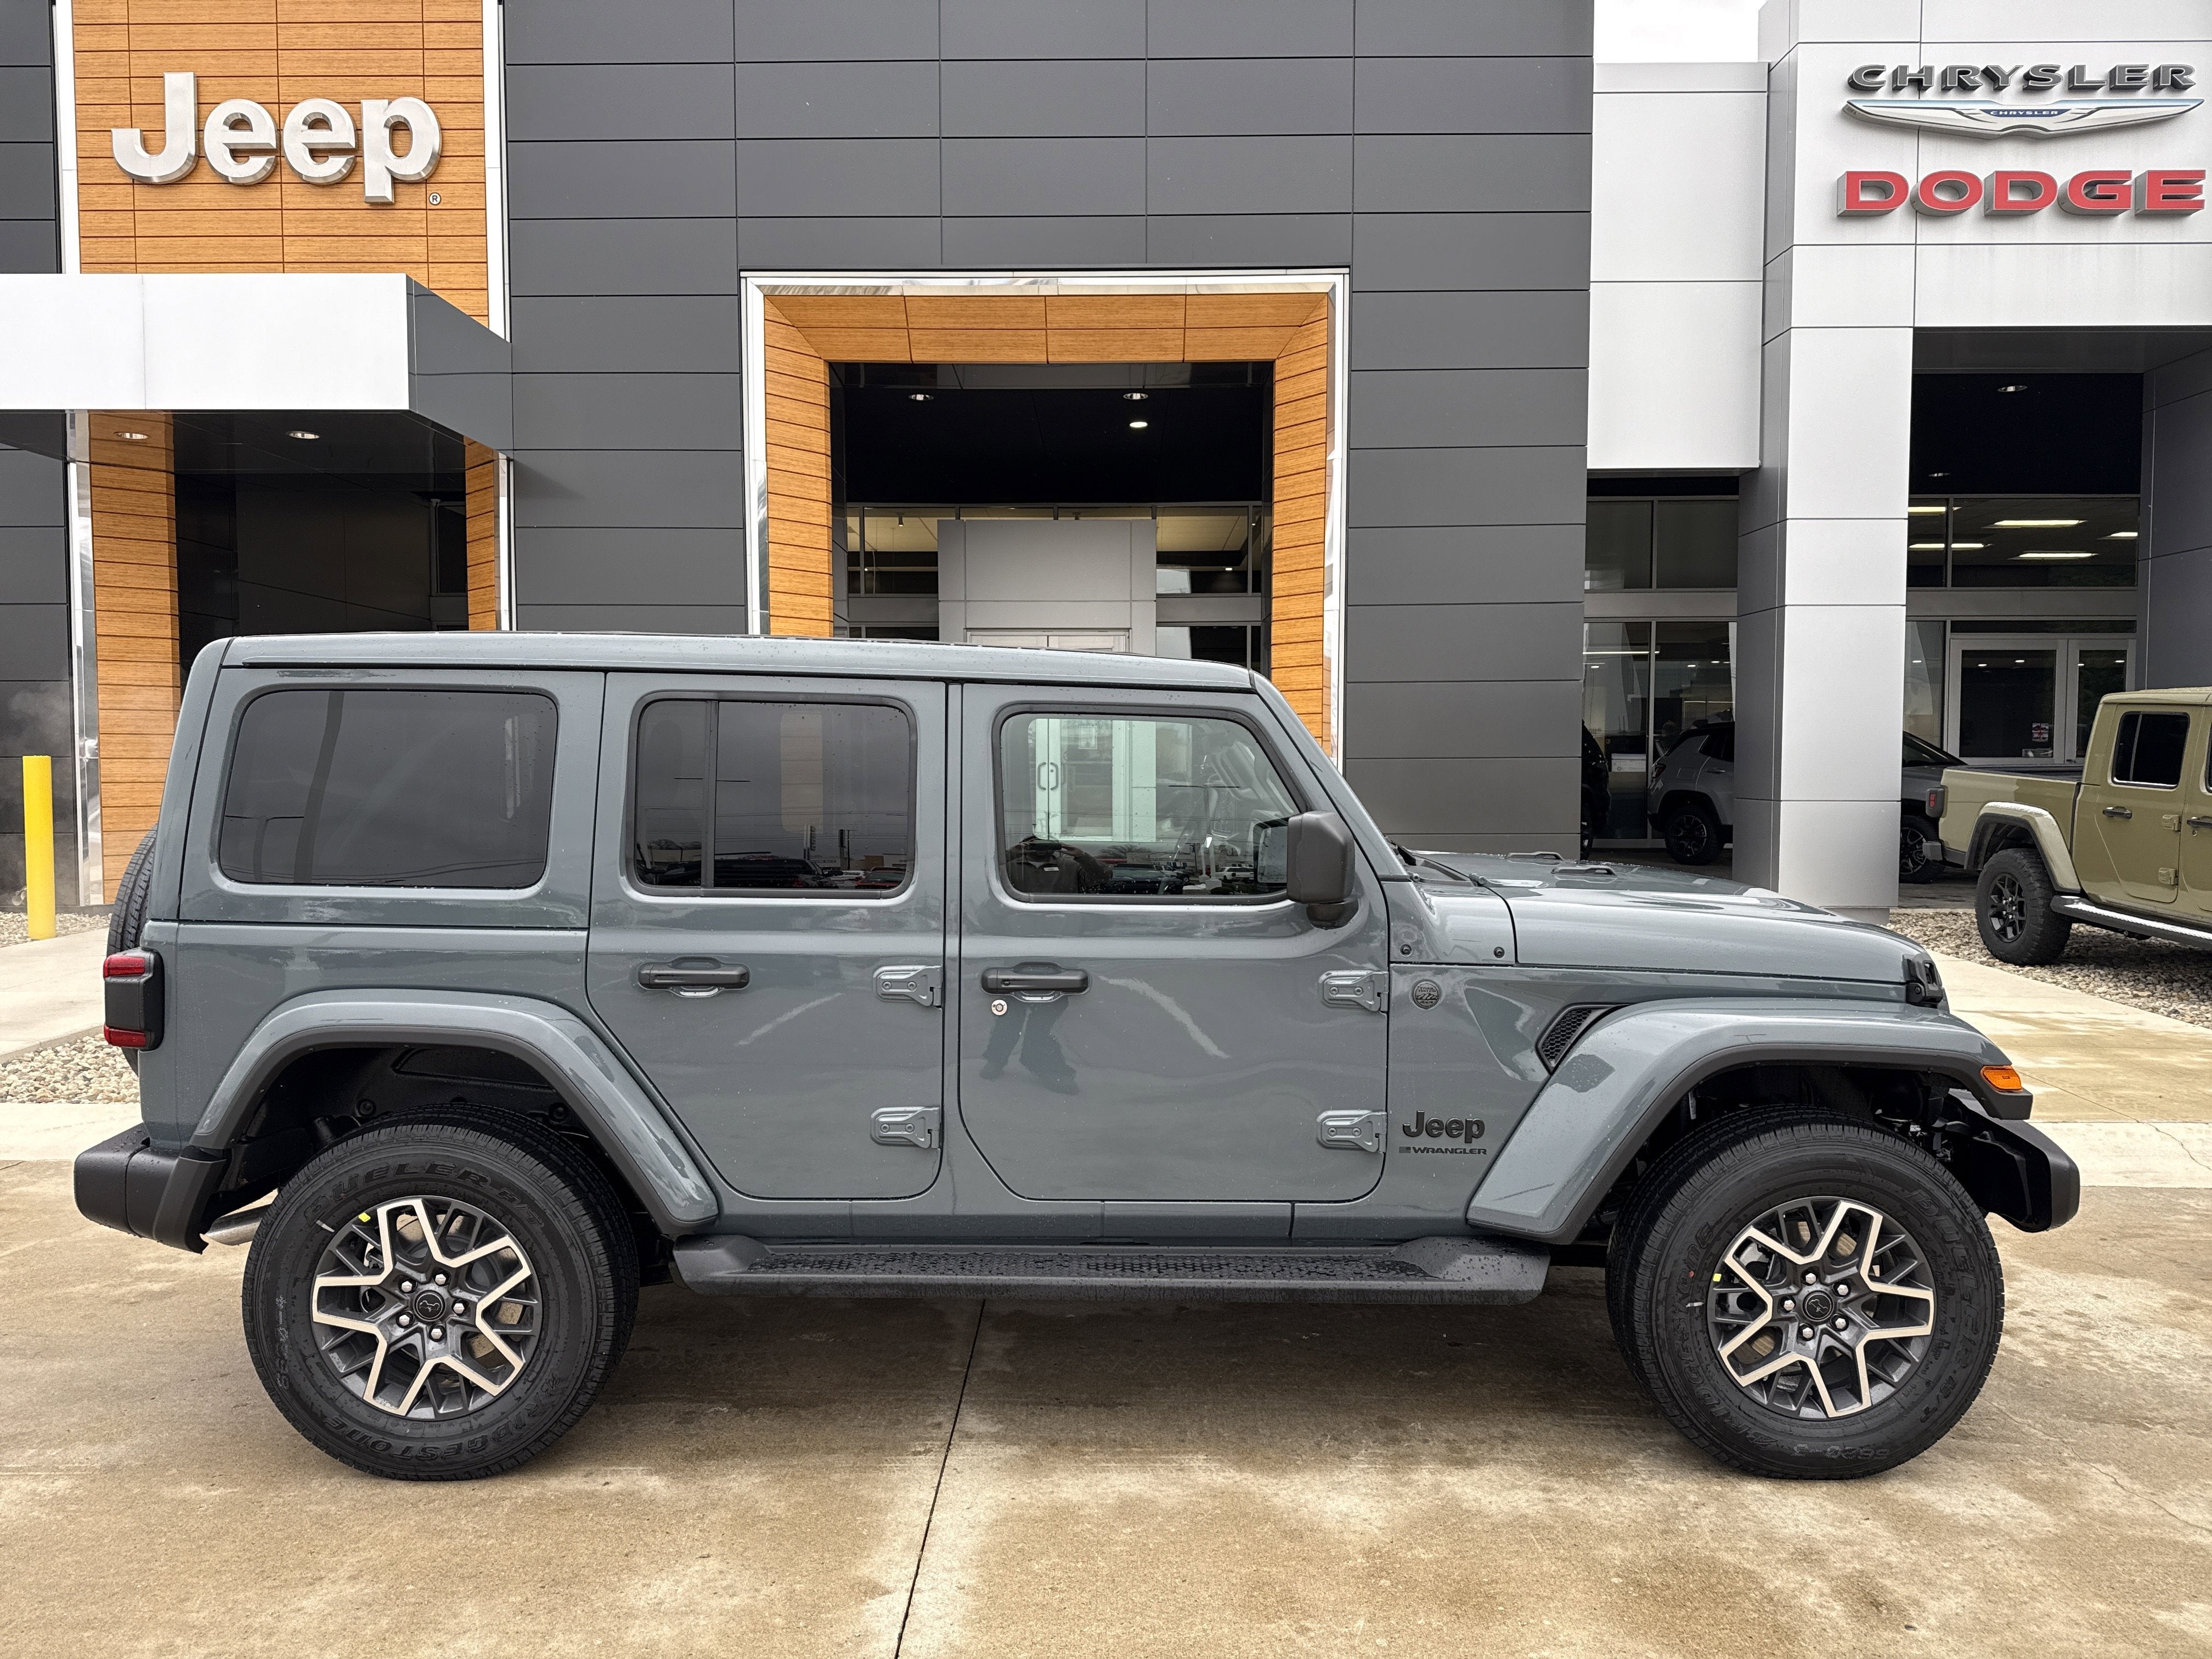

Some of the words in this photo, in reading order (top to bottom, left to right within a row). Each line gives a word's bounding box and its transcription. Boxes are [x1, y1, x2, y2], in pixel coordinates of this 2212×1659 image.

[1848, 64, 2197, 91] CHRYSLER
[111, 72, 442, 204] Jeep
[1837, 170, 2207, 216] DODGE
[1402, 1110, 1485, 1143] Jeep
[1412, 1147, 1487, 1155] WRANGLER
[304, 1159, 491, 1228] DUELER
[321, 1375, 562, 1462] BRIDGESTONE
